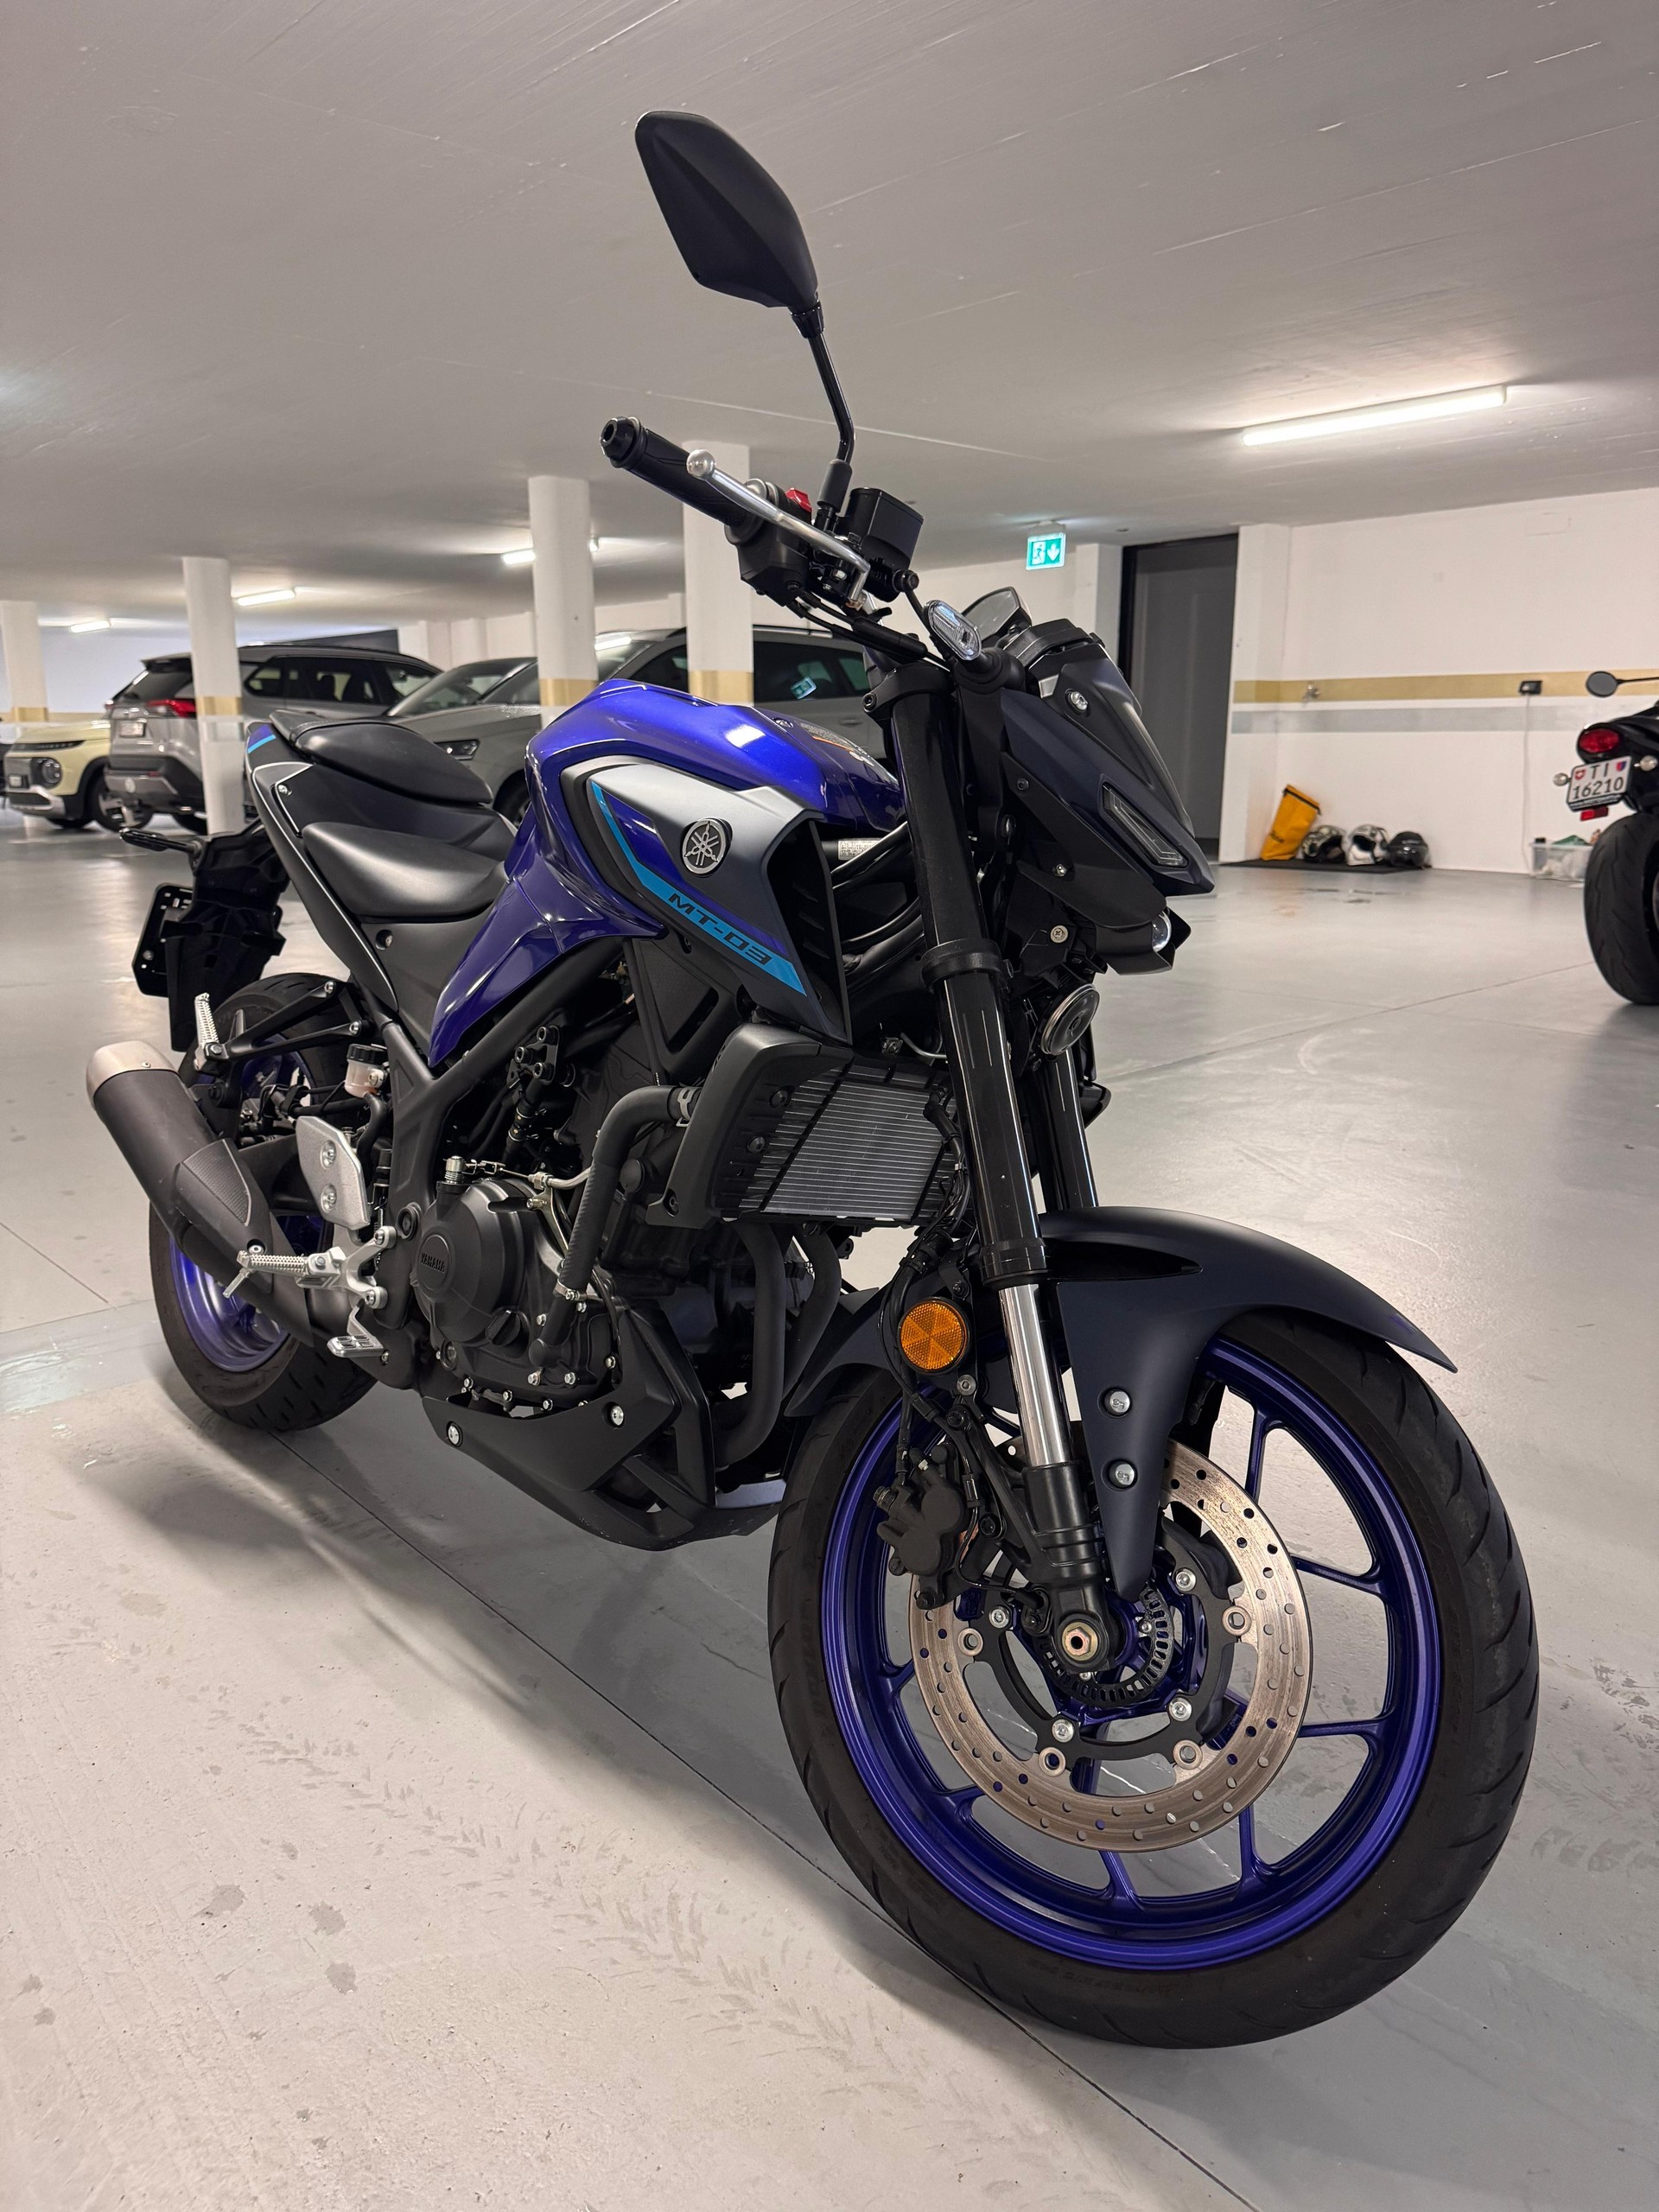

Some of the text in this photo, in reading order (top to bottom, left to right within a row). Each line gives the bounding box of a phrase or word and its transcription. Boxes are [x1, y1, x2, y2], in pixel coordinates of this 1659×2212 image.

[1590, 762, 1610, 779] TI
[1573, 777, 1624, 799] 16210
[669, 893, 772, 965] MT-03
[421, 1253, 445, 1272] YAMAHA
